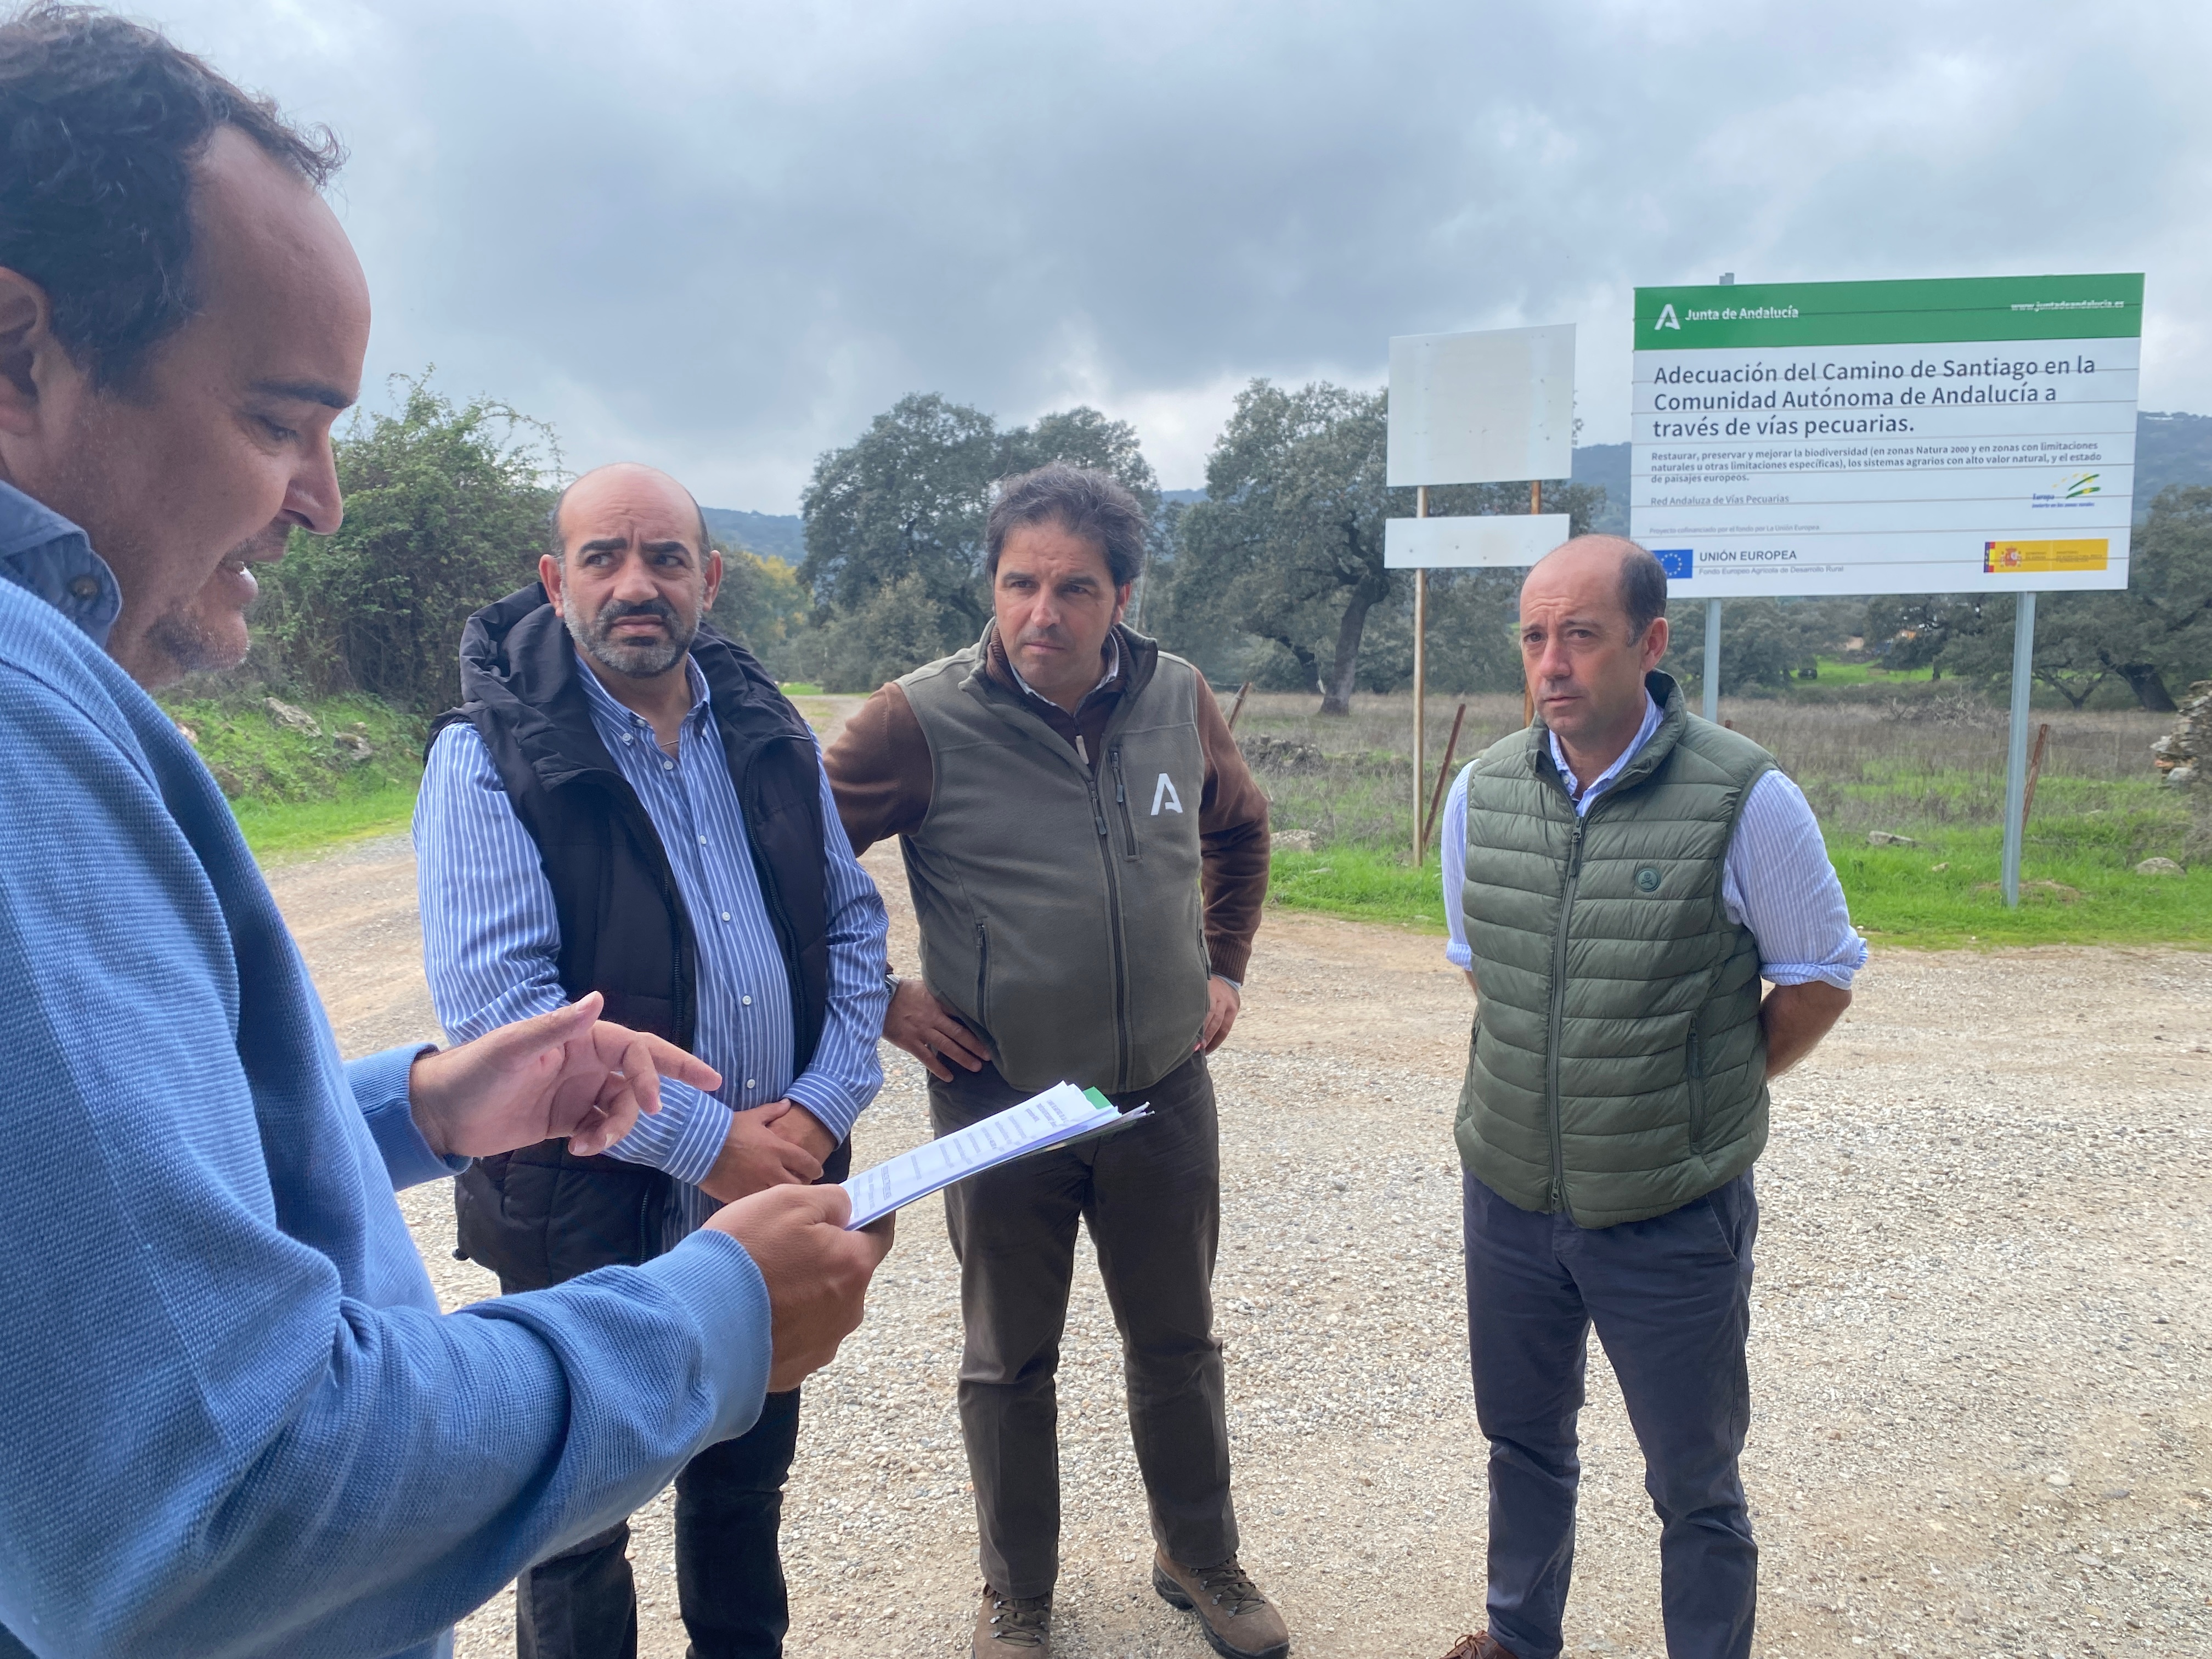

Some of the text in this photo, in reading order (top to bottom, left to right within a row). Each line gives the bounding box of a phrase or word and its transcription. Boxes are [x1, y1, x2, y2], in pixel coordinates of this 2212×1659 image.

[1685, 309, 1719, 320] Junta
[1722, 308, 1737, 319] de
[1739, 304, 1799, 319] Andalucía
[1654, 355, 2096, 384] Adecuación del Camino de Santiago en la
[1654, 382, 2056, 410] Comunidad Autónoma de Andalucía a
[1653, 414, 1915, 438] través de vías pecuarias.
[1651, 453, 1700, 461] Restaurar,
[1702, 451, 1746, 461] preservar
[1756, 449, 1792, 460] mejorar
[1794, 448, 1802, 458] la
[1805, 447, 1868, 457] biodiversidad
[1870, 447, 1885, 457] (en
[1887, 447, 1914, 455] zonas
[1916, 445, 1948, 454] Natura
[2041, 441, 2098, 451] limitaciones
[1651, 463, 1695, 472] naturales
[1705, 462, 1729, 471] otras
[1731, 461, 1786, 471] limitaciones
[1789, 459, 1846, 471] específicas),
[1848, 458, 1862, 467] los
[1865, 458, 1904, 467] sistemas
[1906, 457, 1945, 467] agrarios
[1966, 456, 1984, 465] alto
[1986, 455, 2010, 464] valor
[2012, 454, 2050, 463] natural,
[2051, 454, 2057, 464] y
[2059, 453, 2068, 461] el
[2070, 452, 2102, 461] estado
[1664, 473, 1701, 484] paisajes
[1703, 474, 1750, 483] europeos.
[1651, 494, 1790, 505] Red Andaluza de Vías Pecuarias
[1700, 549, 1797, 561] UNIÓN EUROPEA
